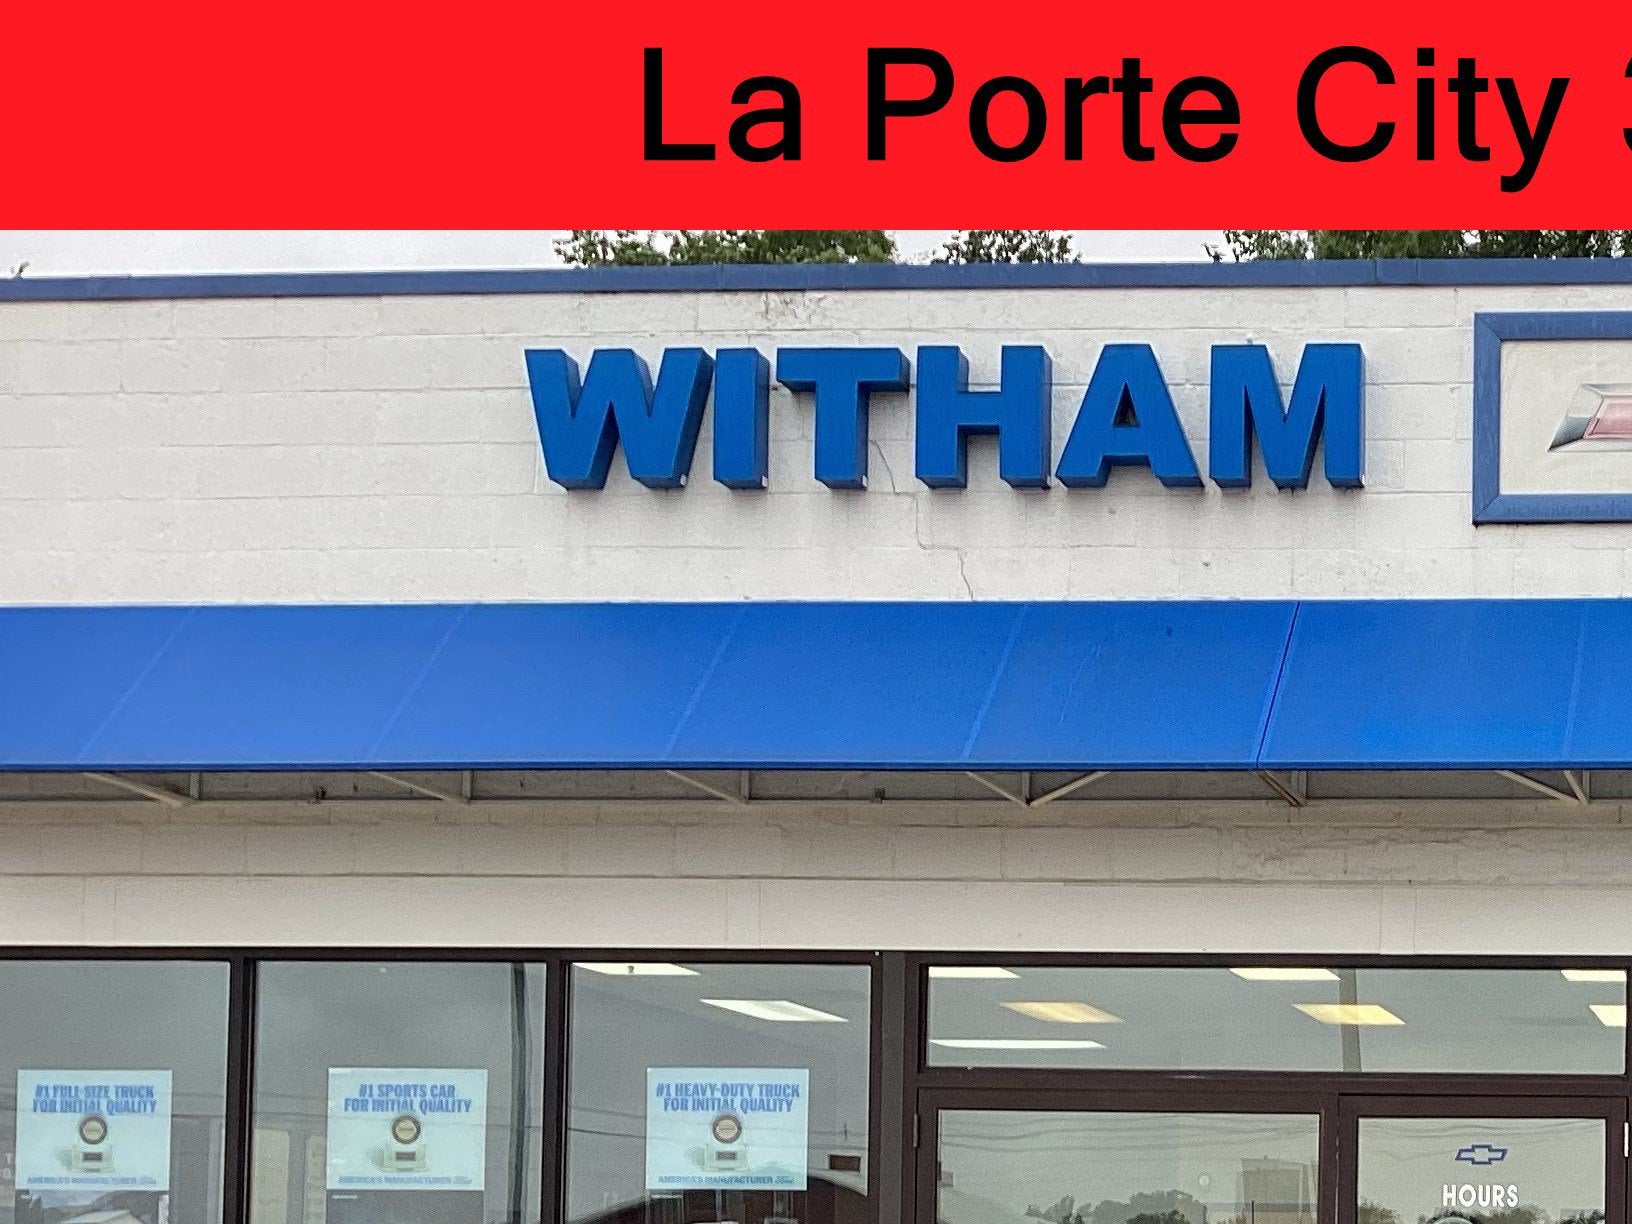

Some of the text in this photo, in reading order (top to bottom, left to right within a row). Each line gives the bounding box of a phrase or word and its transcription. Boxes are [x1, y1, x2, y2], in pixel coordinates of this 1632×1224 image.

[524, 342, 1366, 491] WITHAM
[114, 1085, 155, 1099] TRUCK
[359, 1084, 456, 1098] #1 SPORTS CAR
[656, 1083, 800, 1098] #1 HEAVY-DUTY TRUCK
[33, 1100, 157, 1115] FOR INITIAL QUALITY
[344, 1098, 472, 1115] FOR INITIAL QUALITY
[663, 1097, 794, 1114] FOR INITIAL QUALITY
[1442, 1184, 1519, 1207] HOURS
